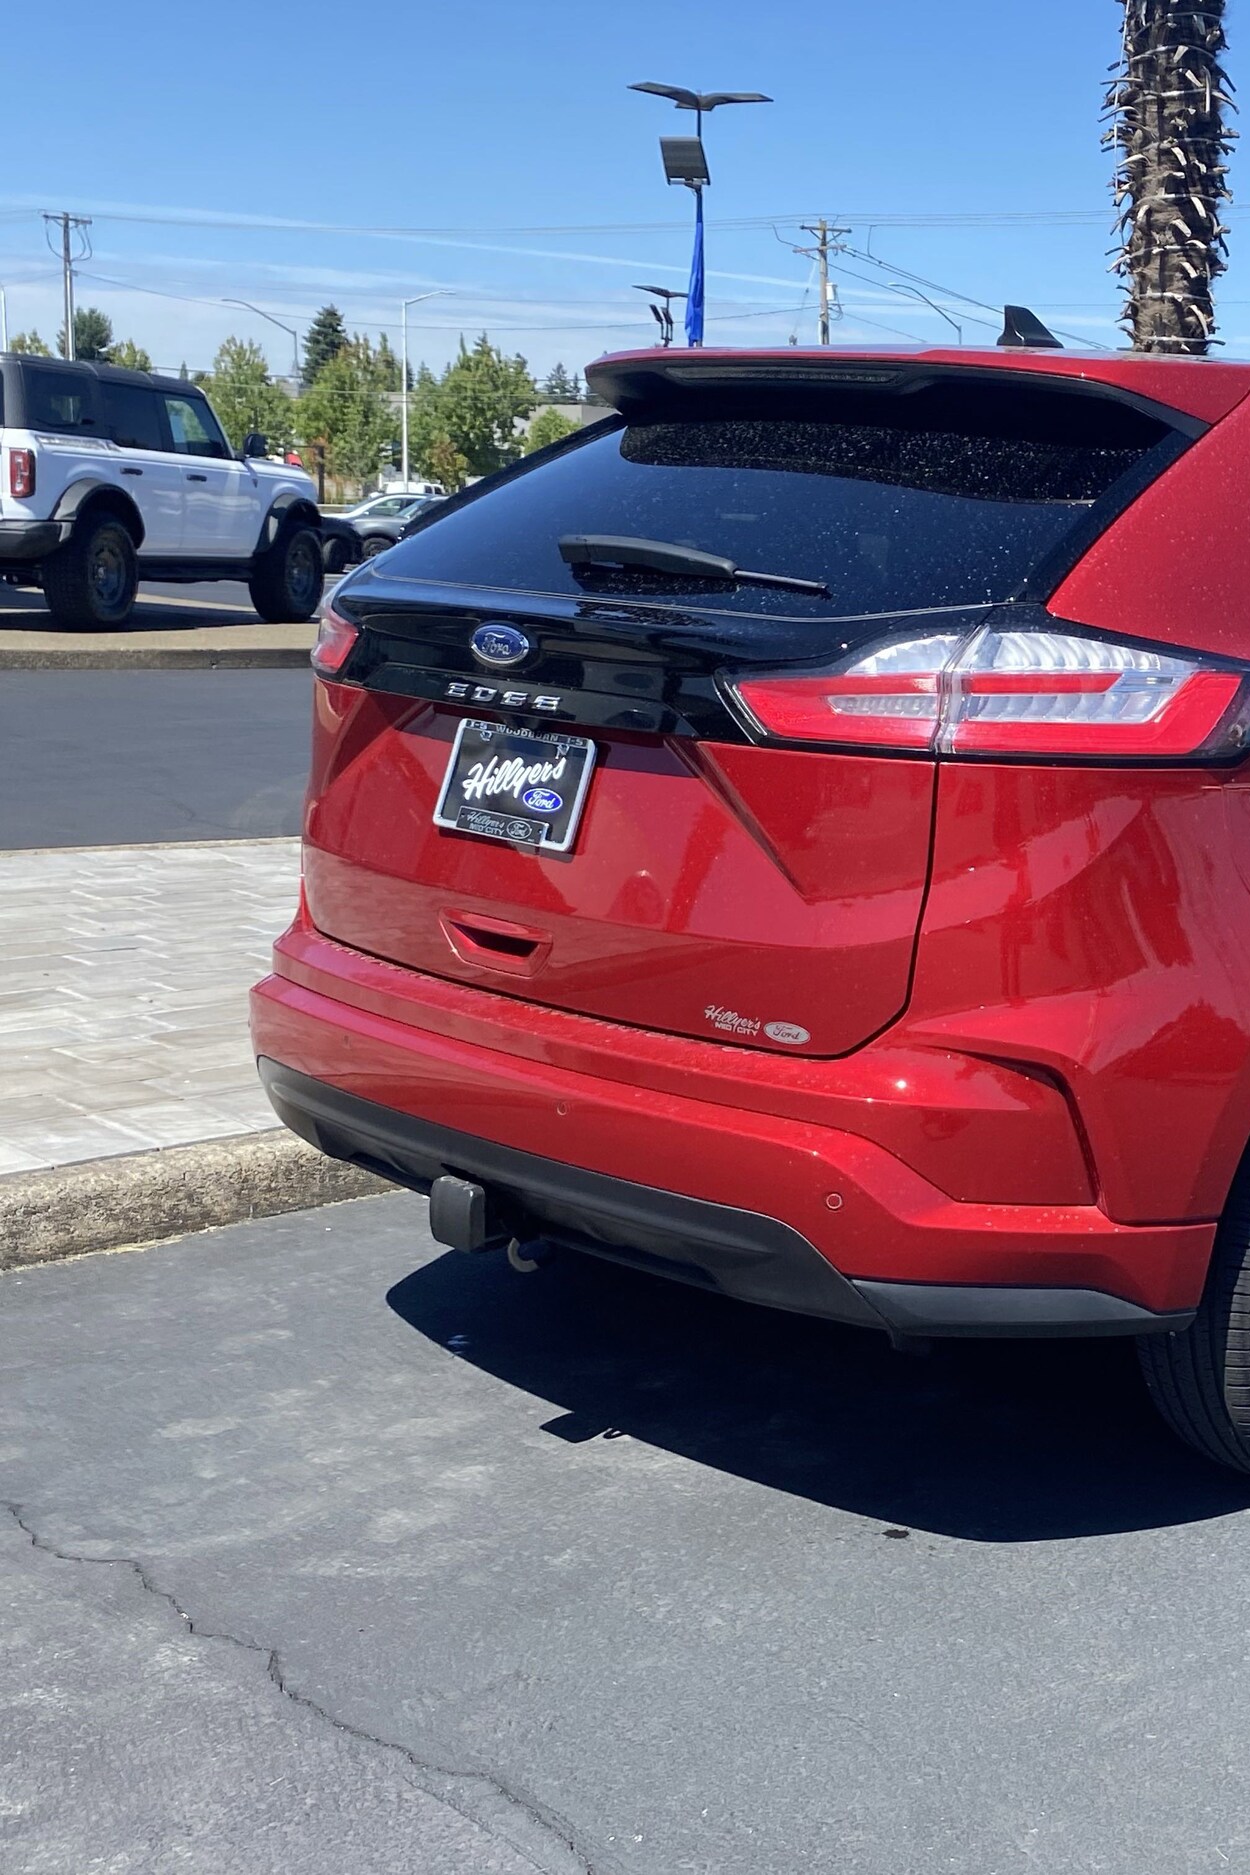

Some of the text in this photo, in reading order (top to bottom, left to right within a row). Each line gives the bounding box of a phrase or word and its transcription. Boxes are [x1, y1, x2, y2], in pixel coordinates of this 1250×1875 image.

[446, 682, 561, 711] EDGE
[485, 827, 505, 836] CITY
[737, 1027, 758, 1037] CITY
